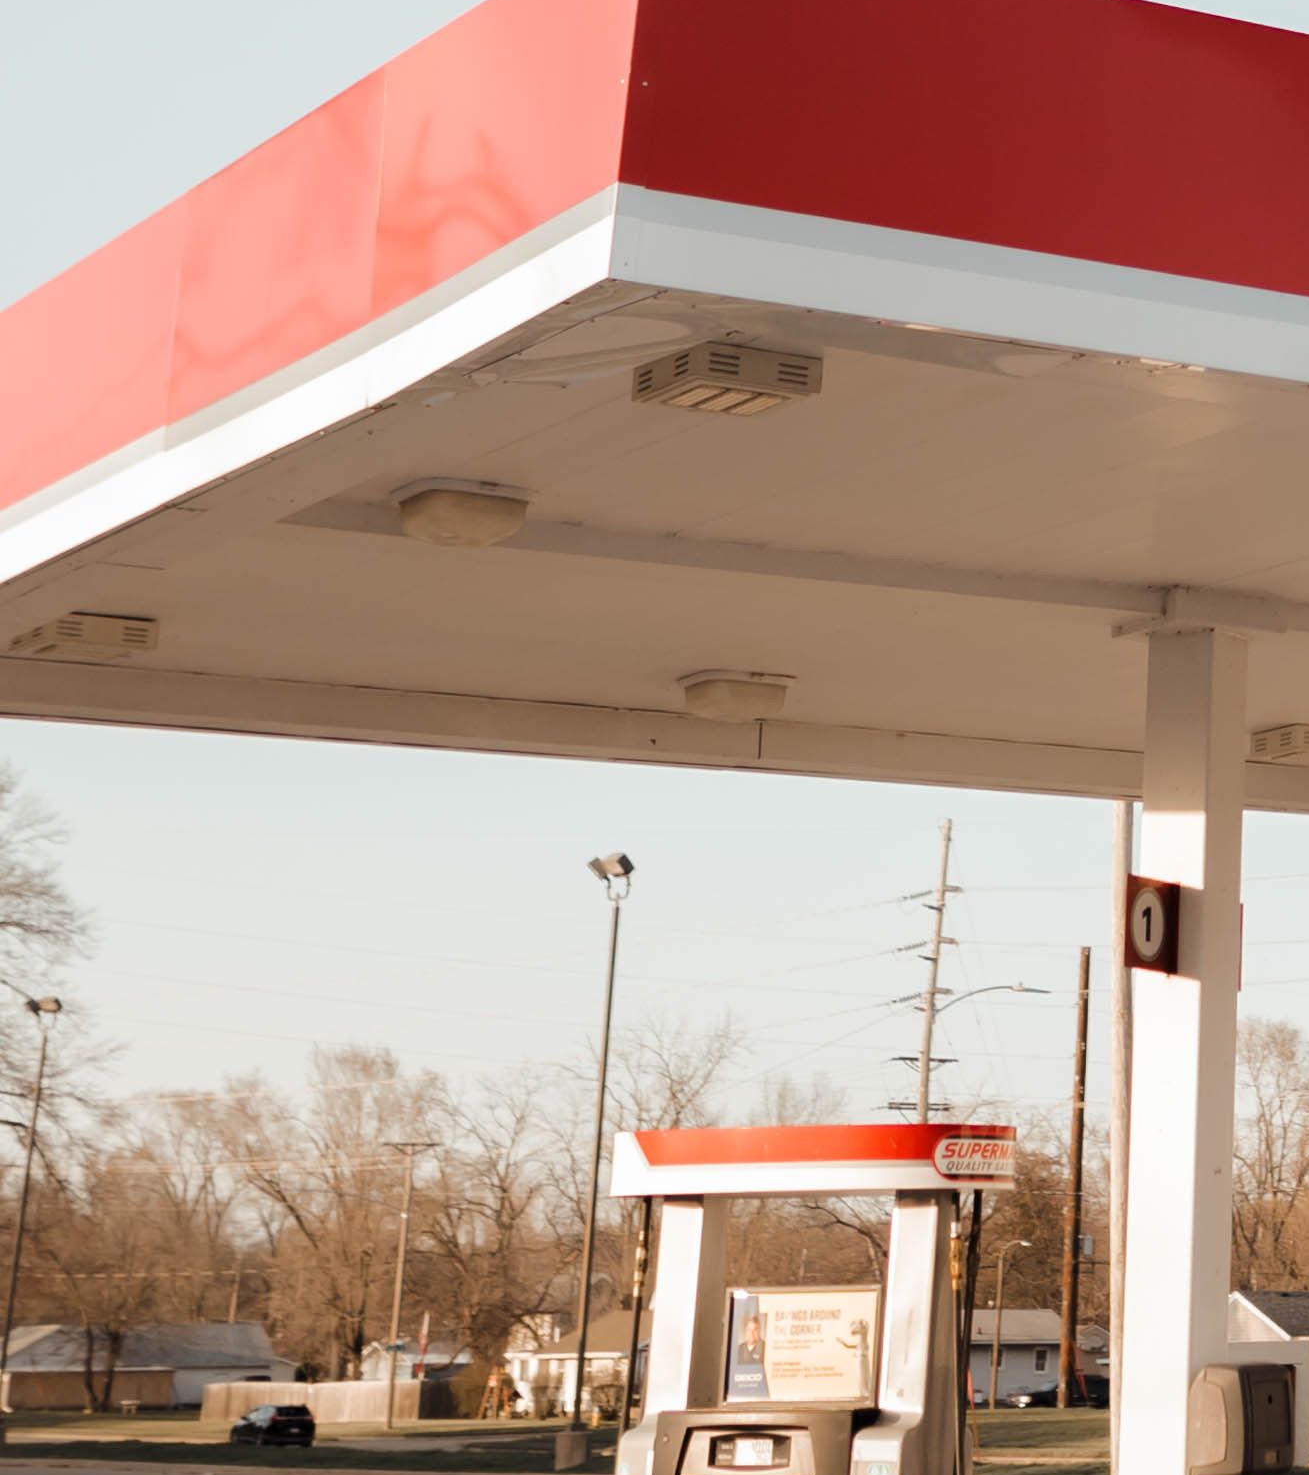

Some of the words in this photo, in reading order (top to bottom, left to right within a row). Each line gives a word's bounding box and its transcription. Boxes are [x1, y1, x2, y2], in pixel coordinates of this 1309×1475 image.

[1142, 906, 1152, 942] 1
[942, 1142, 1012, 1159] SUPERM
[946, 1161, 992, 1171] QUALITY
